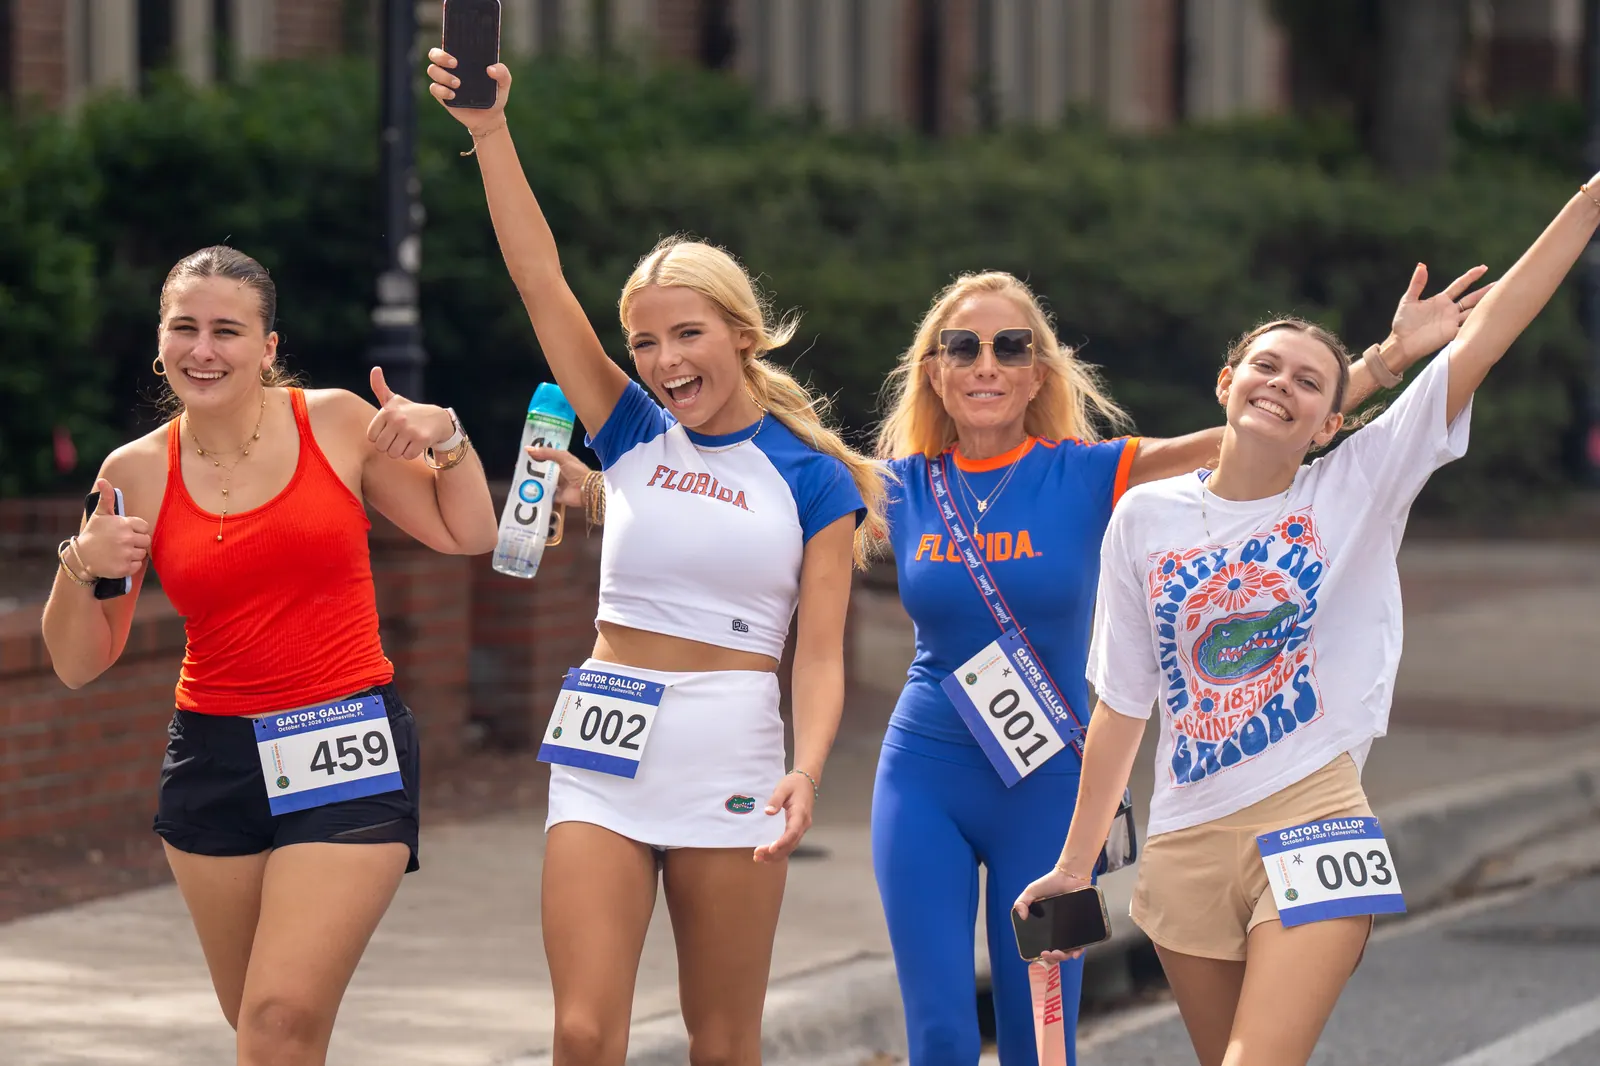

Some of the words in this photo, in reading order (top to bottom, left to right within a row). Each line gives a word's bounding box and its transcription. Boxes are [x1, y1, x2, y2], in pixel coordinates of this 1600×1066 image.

[647, 465, 748, 510] FLORIDA
[952, 524, 968, 542] Gators
[964, 548, 981, 568] Gators
[978, 574, 995, 596] Gators
[993, 601, 1011, 624] Gators
[1154, 548, 1228, 714] UNIVERSITY
[1240, 535, 1275, 563] OF
[1012, 653, 1025, 671] October
[580, 673, 607, 684] GATOR
[609, 677, 646, 691] GALLOP
[1017, 648, 1042, 682] GATOR
[1040, 682, 1068, 720] GALLOP
[1223, 682, 1262, 713] 185
[276, 712, 316, 726] GATOR
[319, 702, 363, 717] GALLOP
[1172, 665, 1316, 784] GATORS
[278, 724, 300, 732] October
[580, 706, 646, 750] 002
[989, 689, 1048, 767] 001
[310, 731, 388, 775] 459
[1280, 825, 1320, 840] GATOR
[1323, 820, 1364, 831] GALLOP
[1282, 838, 1305, 846] October
[1316, 850, 1392, 890] 003
[1048, 965, 1060, 992] MU
[1045, 995, 1061, 1025] PHI
